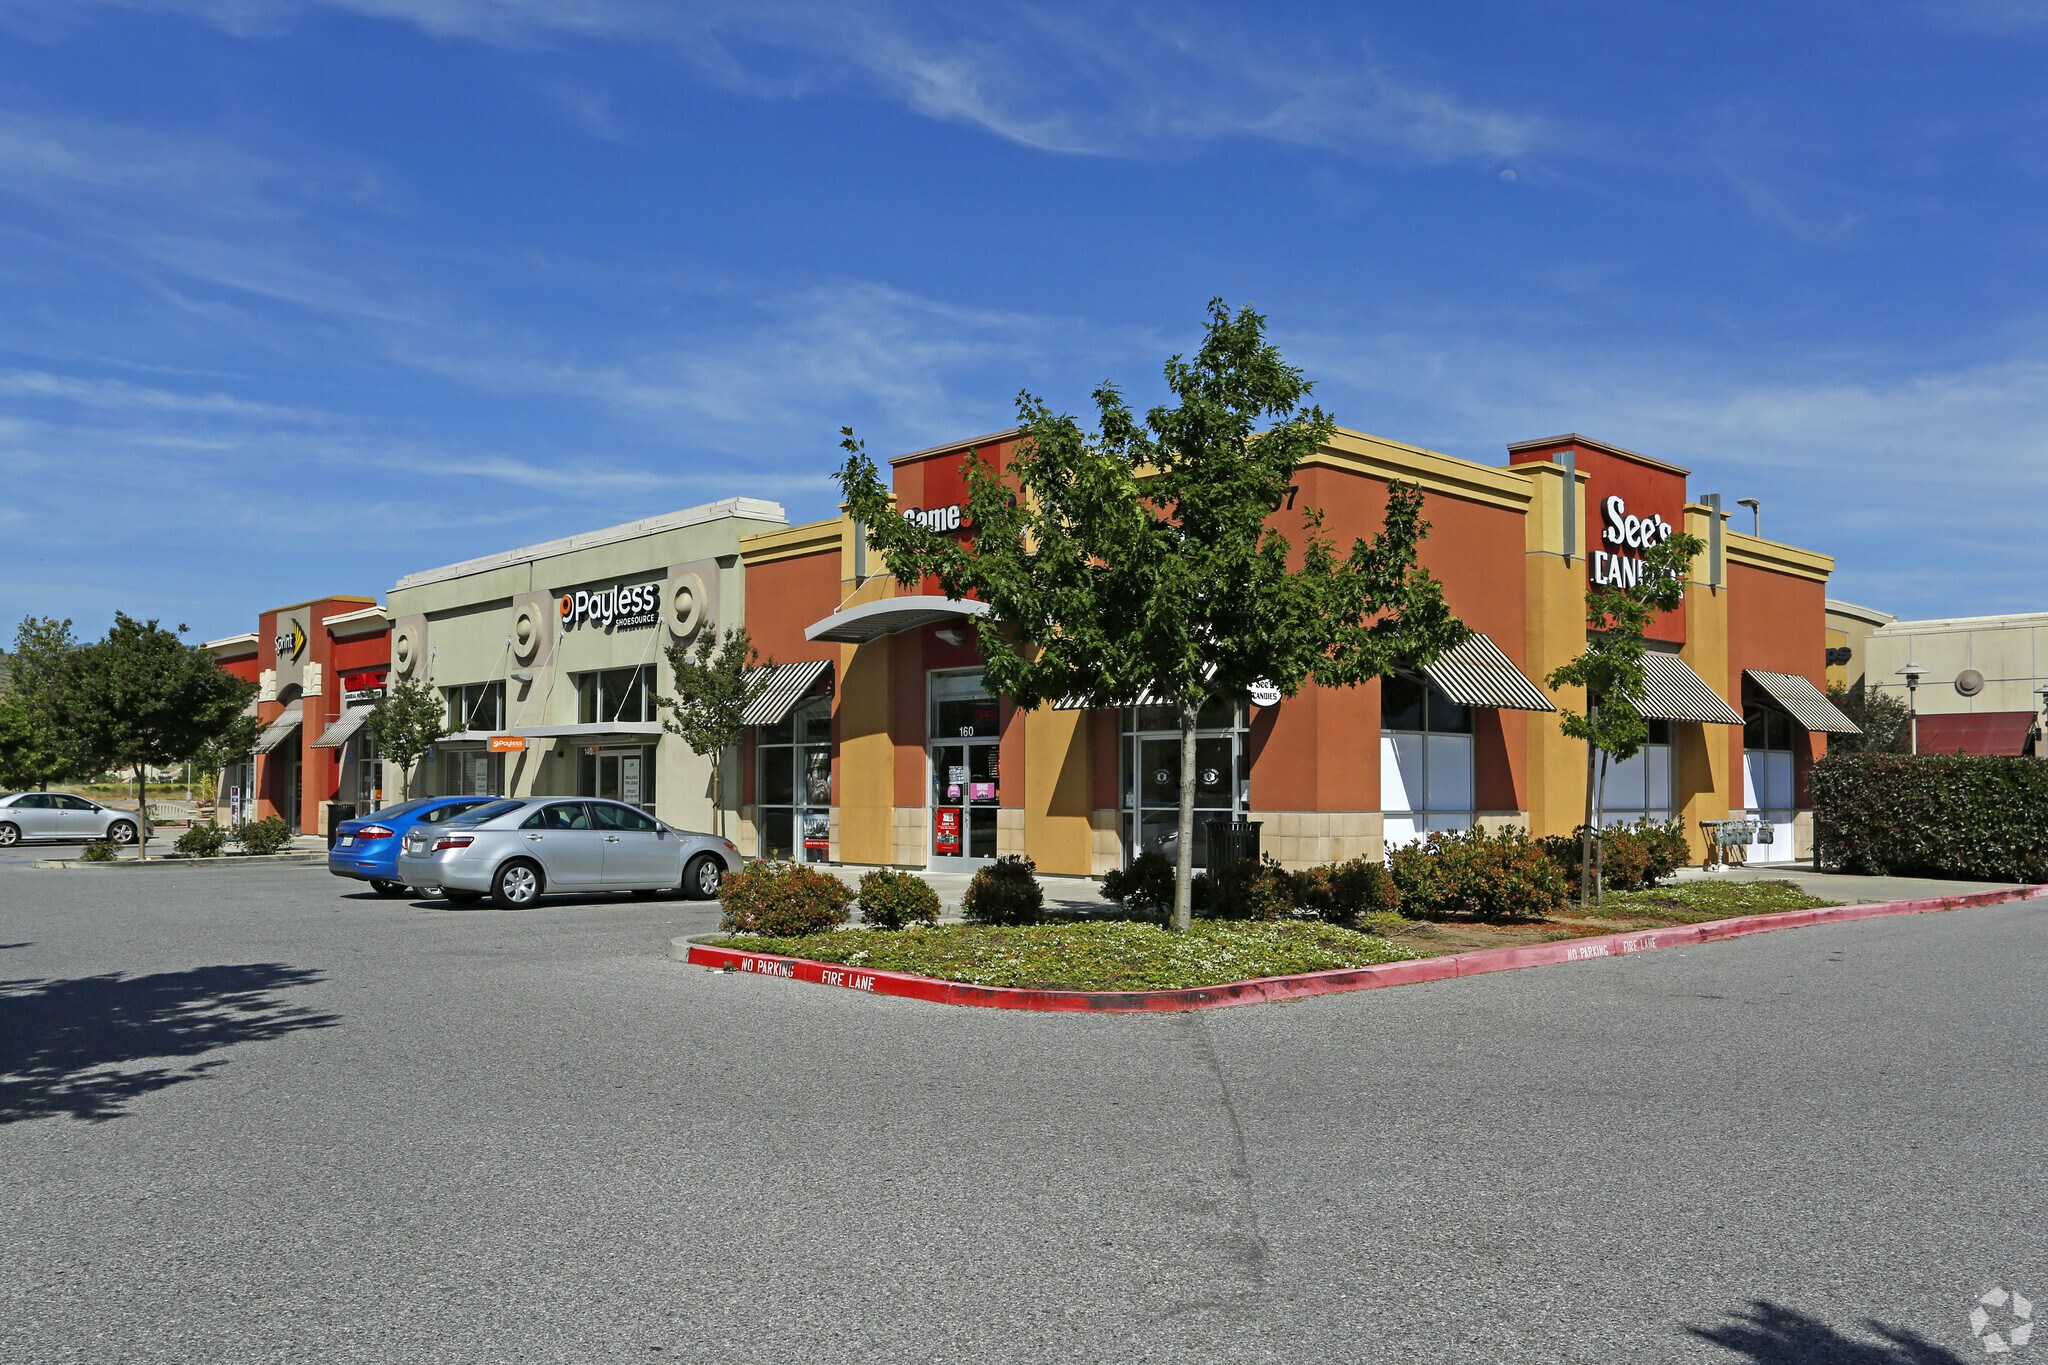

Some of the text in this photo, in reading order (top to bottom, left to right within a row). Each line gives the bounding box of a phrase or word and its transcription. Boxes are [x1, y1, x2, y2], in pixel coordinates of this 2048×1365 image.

[1606, 495, 1672, 549] See's
[575, 584, 655, 626] Payless
[615, 613, 655, 627] SHOESOURCE
[275, 632, 293, 656] Sprint
[1252, 692, 1278, 701] CANDIES
[959, 726, 974, 737] 160
[1567, 937, 1657, 961] NO PARKING FIRE LANE
[741, 957, 876, 992] NO PARKING FIRE LANE
